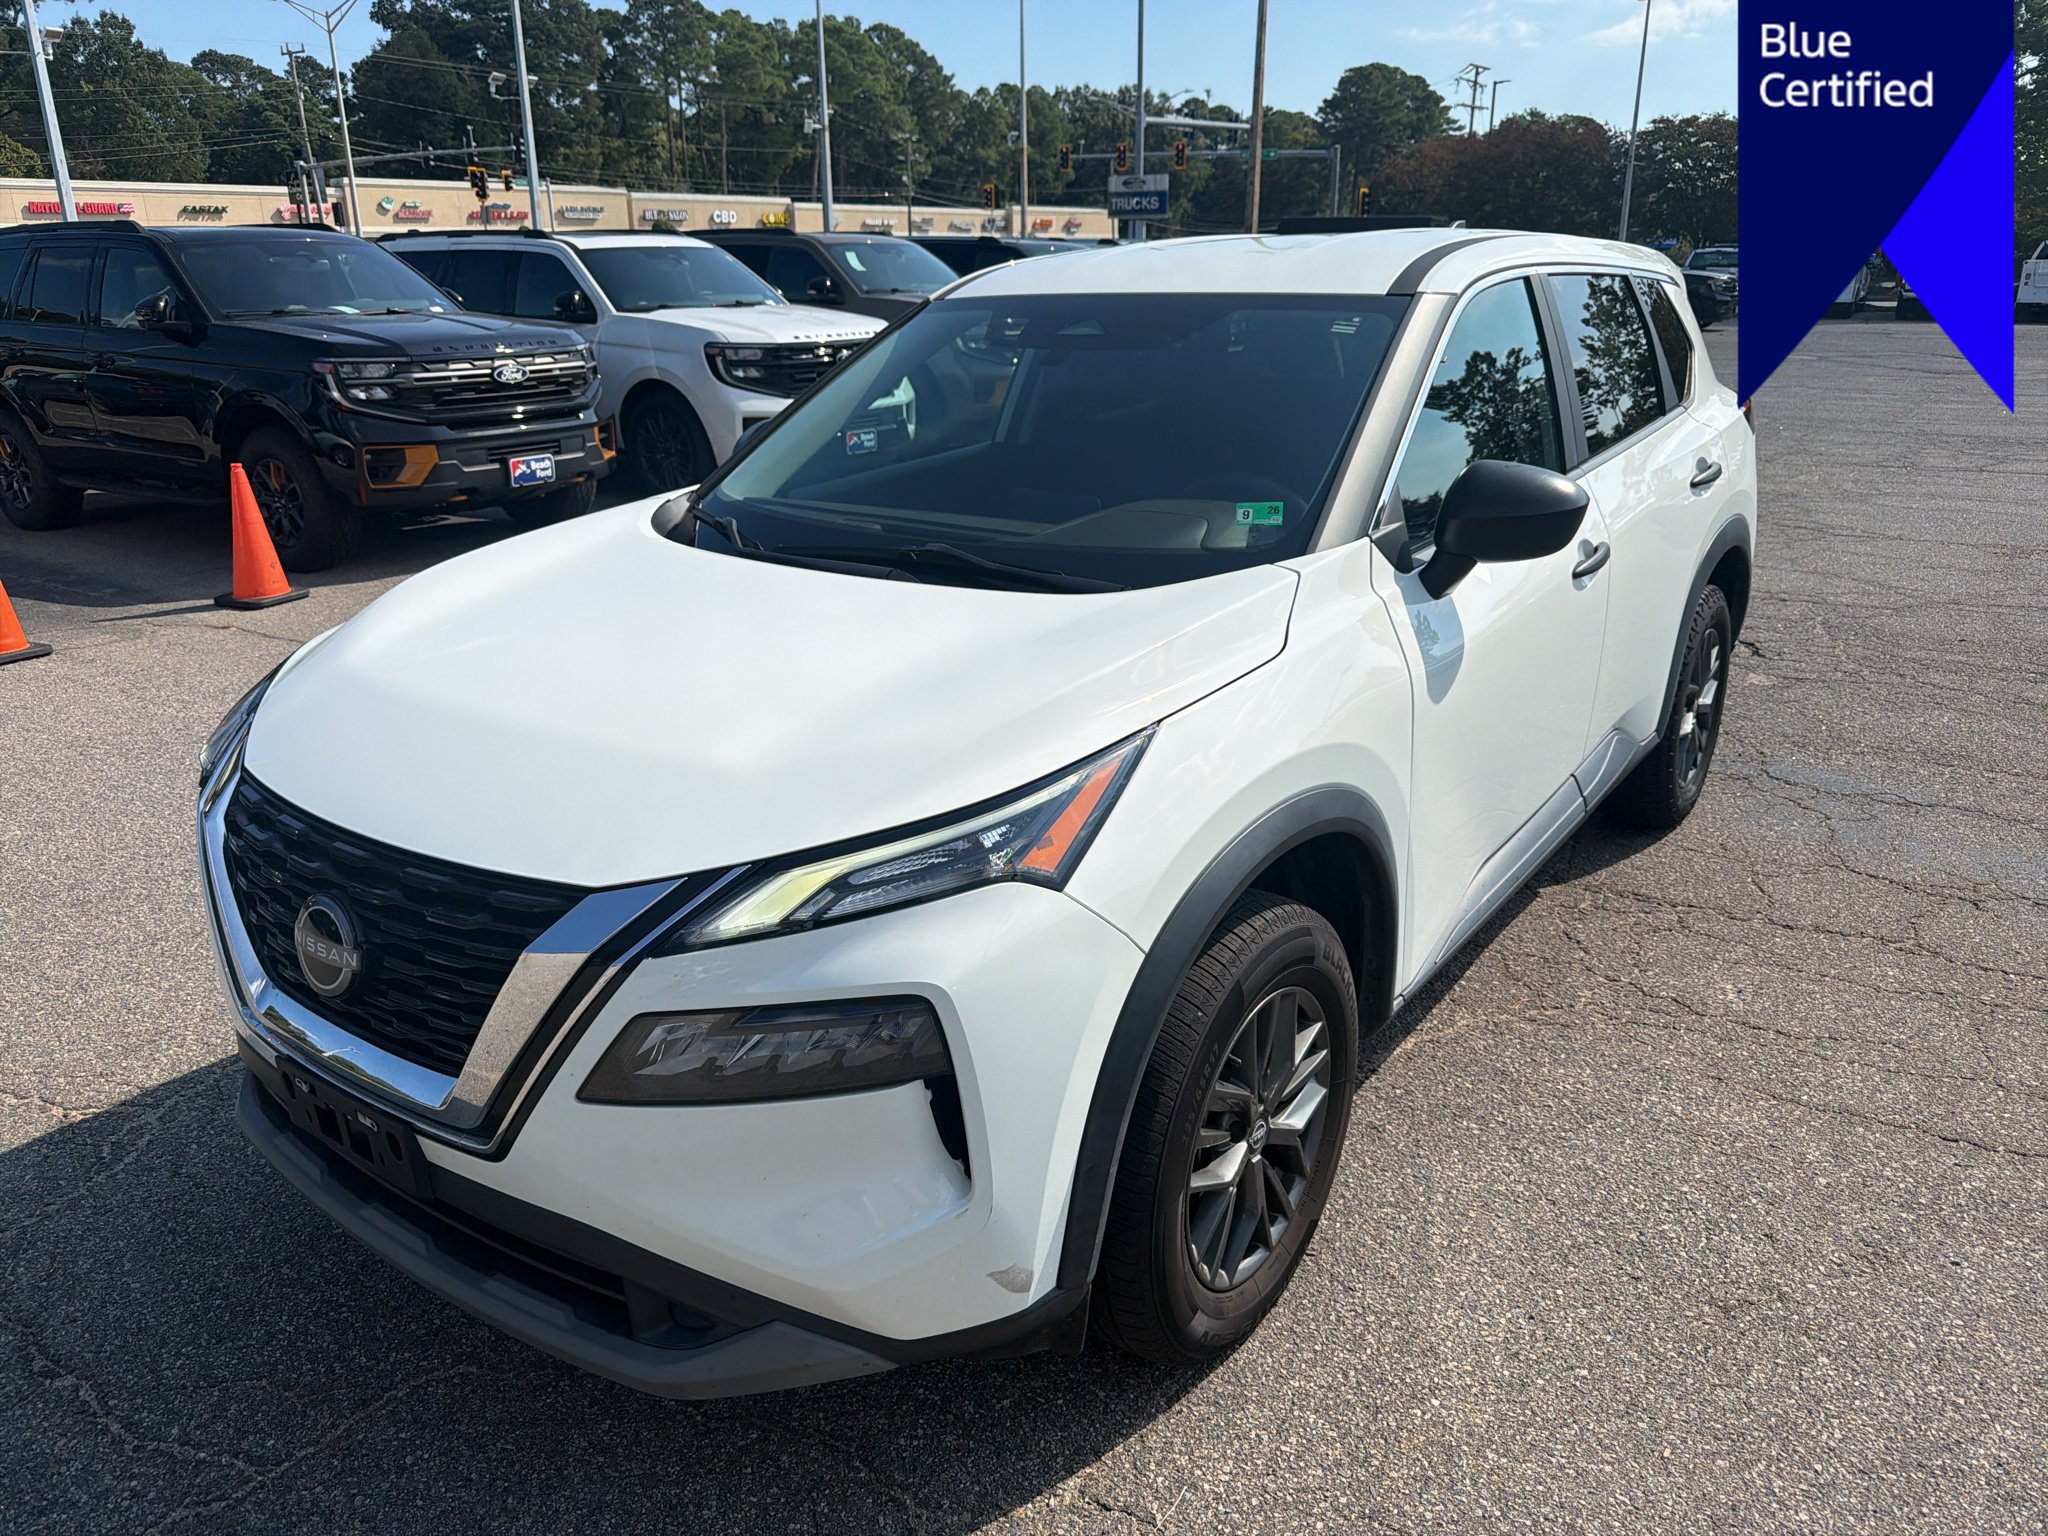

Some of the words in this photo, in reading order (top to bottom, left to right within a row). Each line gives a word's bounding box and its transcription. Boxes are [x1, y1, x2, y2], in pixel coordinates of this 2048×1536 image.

[28, 201, 82, 214] NATIOL
[83, 202, 119, 214] GUARD
[1111, 196, 1160, 210] TRUCKS
[713, 210, 737, 224] CBD
[530, 459, 551, 470] Beach
[536, 468, 552, 478] Ford
[1242, 509, 1250, 520] 9
[296, 930, 357, 967] NISSAN
